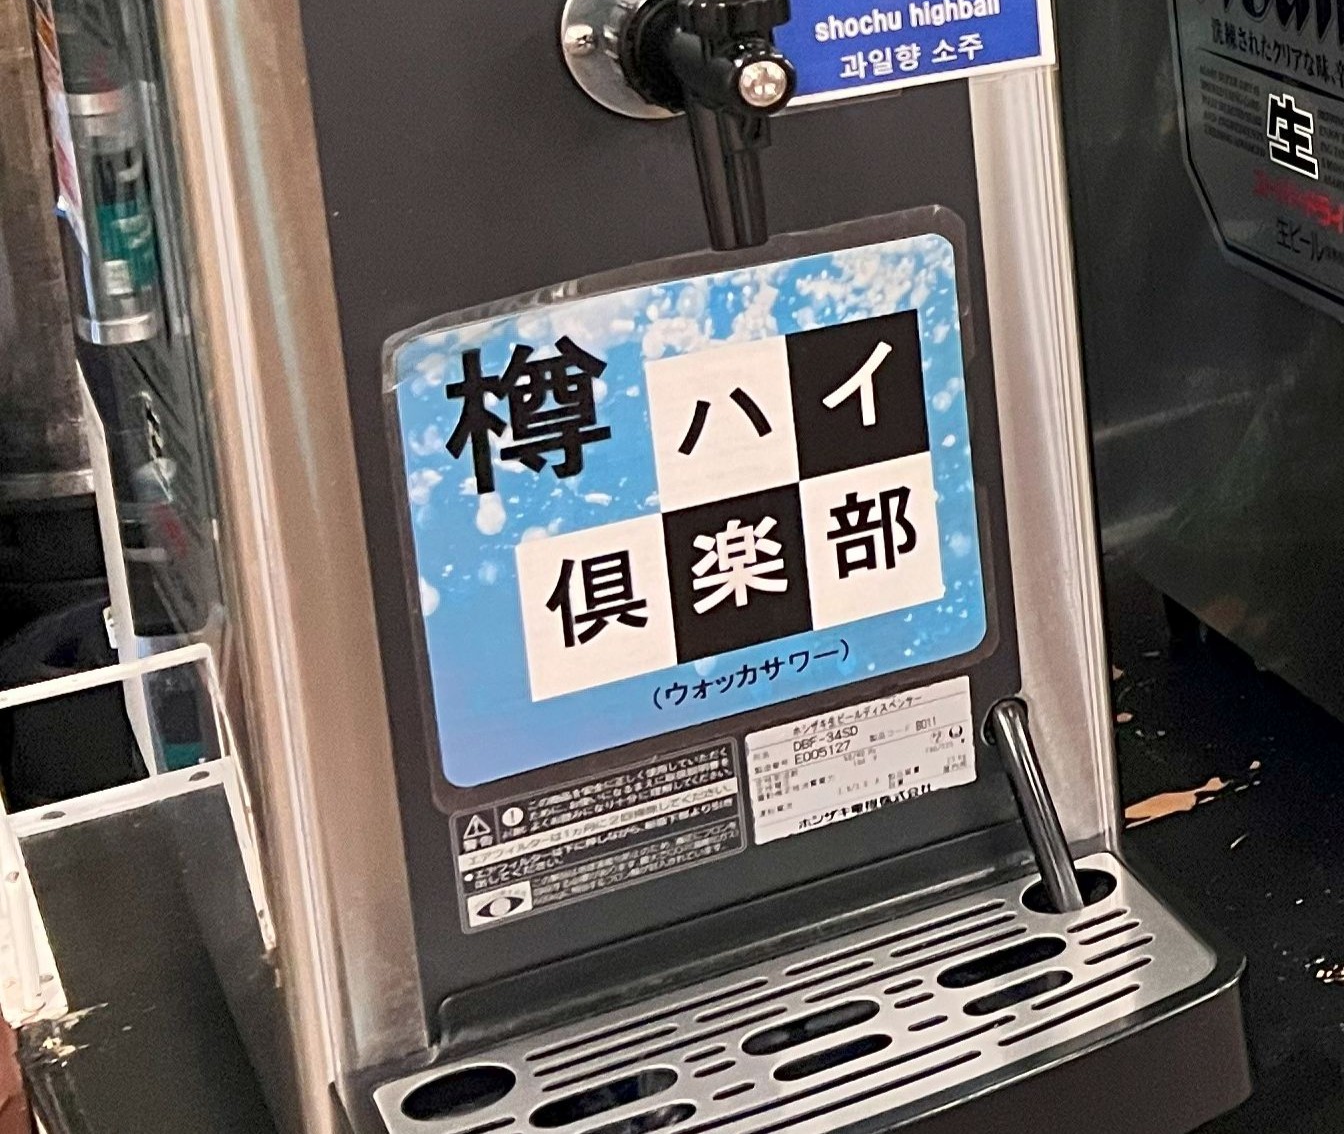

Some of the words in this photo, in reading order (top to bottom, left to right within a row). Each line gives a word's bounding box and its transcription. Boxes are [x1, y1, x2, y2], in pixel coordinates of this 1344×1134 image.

[814, 0, 902, 43] shochu
[839, 37, 921, 80] 과일향
[931, 31, 985, 70] 소주
[1266, 92, 1320, 181] 生
[445, 334, 894, 495] 樽ハイ
[546, 483, 918, 648] 倶楽部
[653, 637, 852, 710] (ウォッカサワー)
[793, 724, 860, 753] DBF-34SD
[794, 739, 852, 766] E005127
